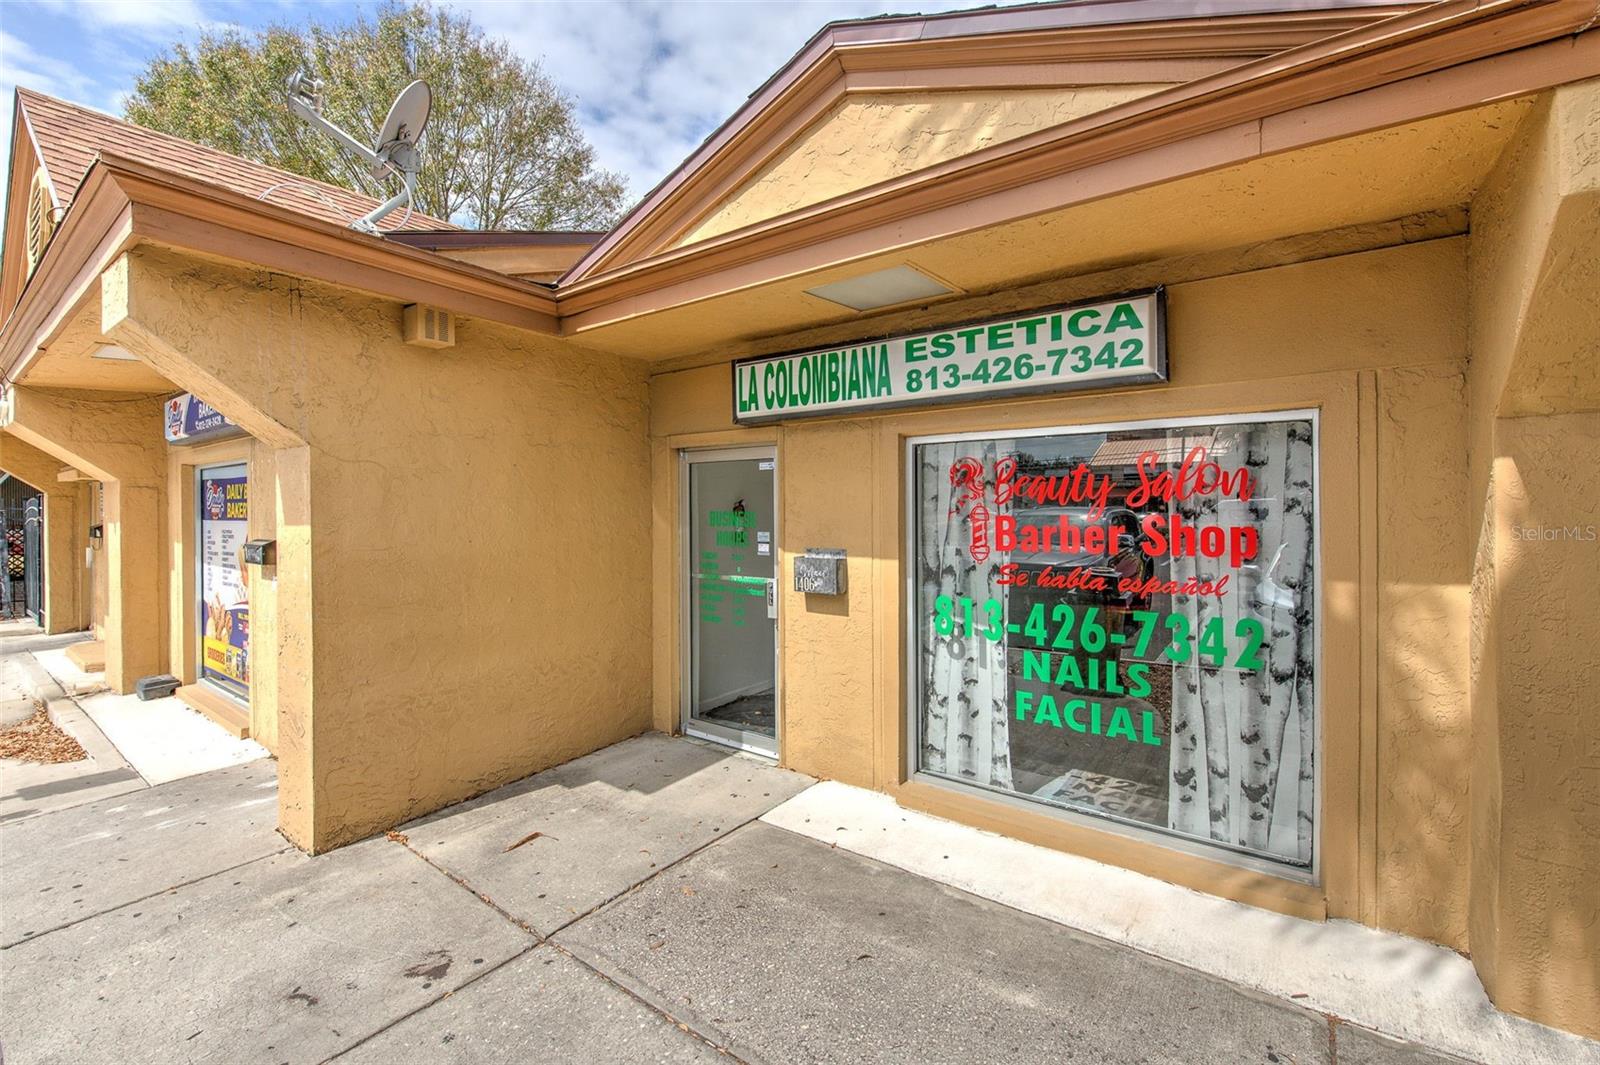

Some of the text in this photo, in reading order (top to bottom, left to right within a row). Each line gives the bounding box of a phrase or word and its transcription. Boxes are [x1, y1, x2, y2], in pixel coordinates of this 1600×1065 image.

[905, 303, 1144, 363] ESTETICA
[738, 345, 892, 413] LA COLOMBIANA
[906, 338, 1144, 393] 813-426-7342
[993, 446, 1257, 523] Beauty Salon
[994, 513, 1259, 567] Barber Shop
[795, 576, 815, 591] 1406
[995, 563, 1229, 599] Se habla español
[934, 594, 1265, 670] 813-426-7342
[1023, 649, 1152, 698] NAILS
[1014, 690, 1162, 745] FACIAL
